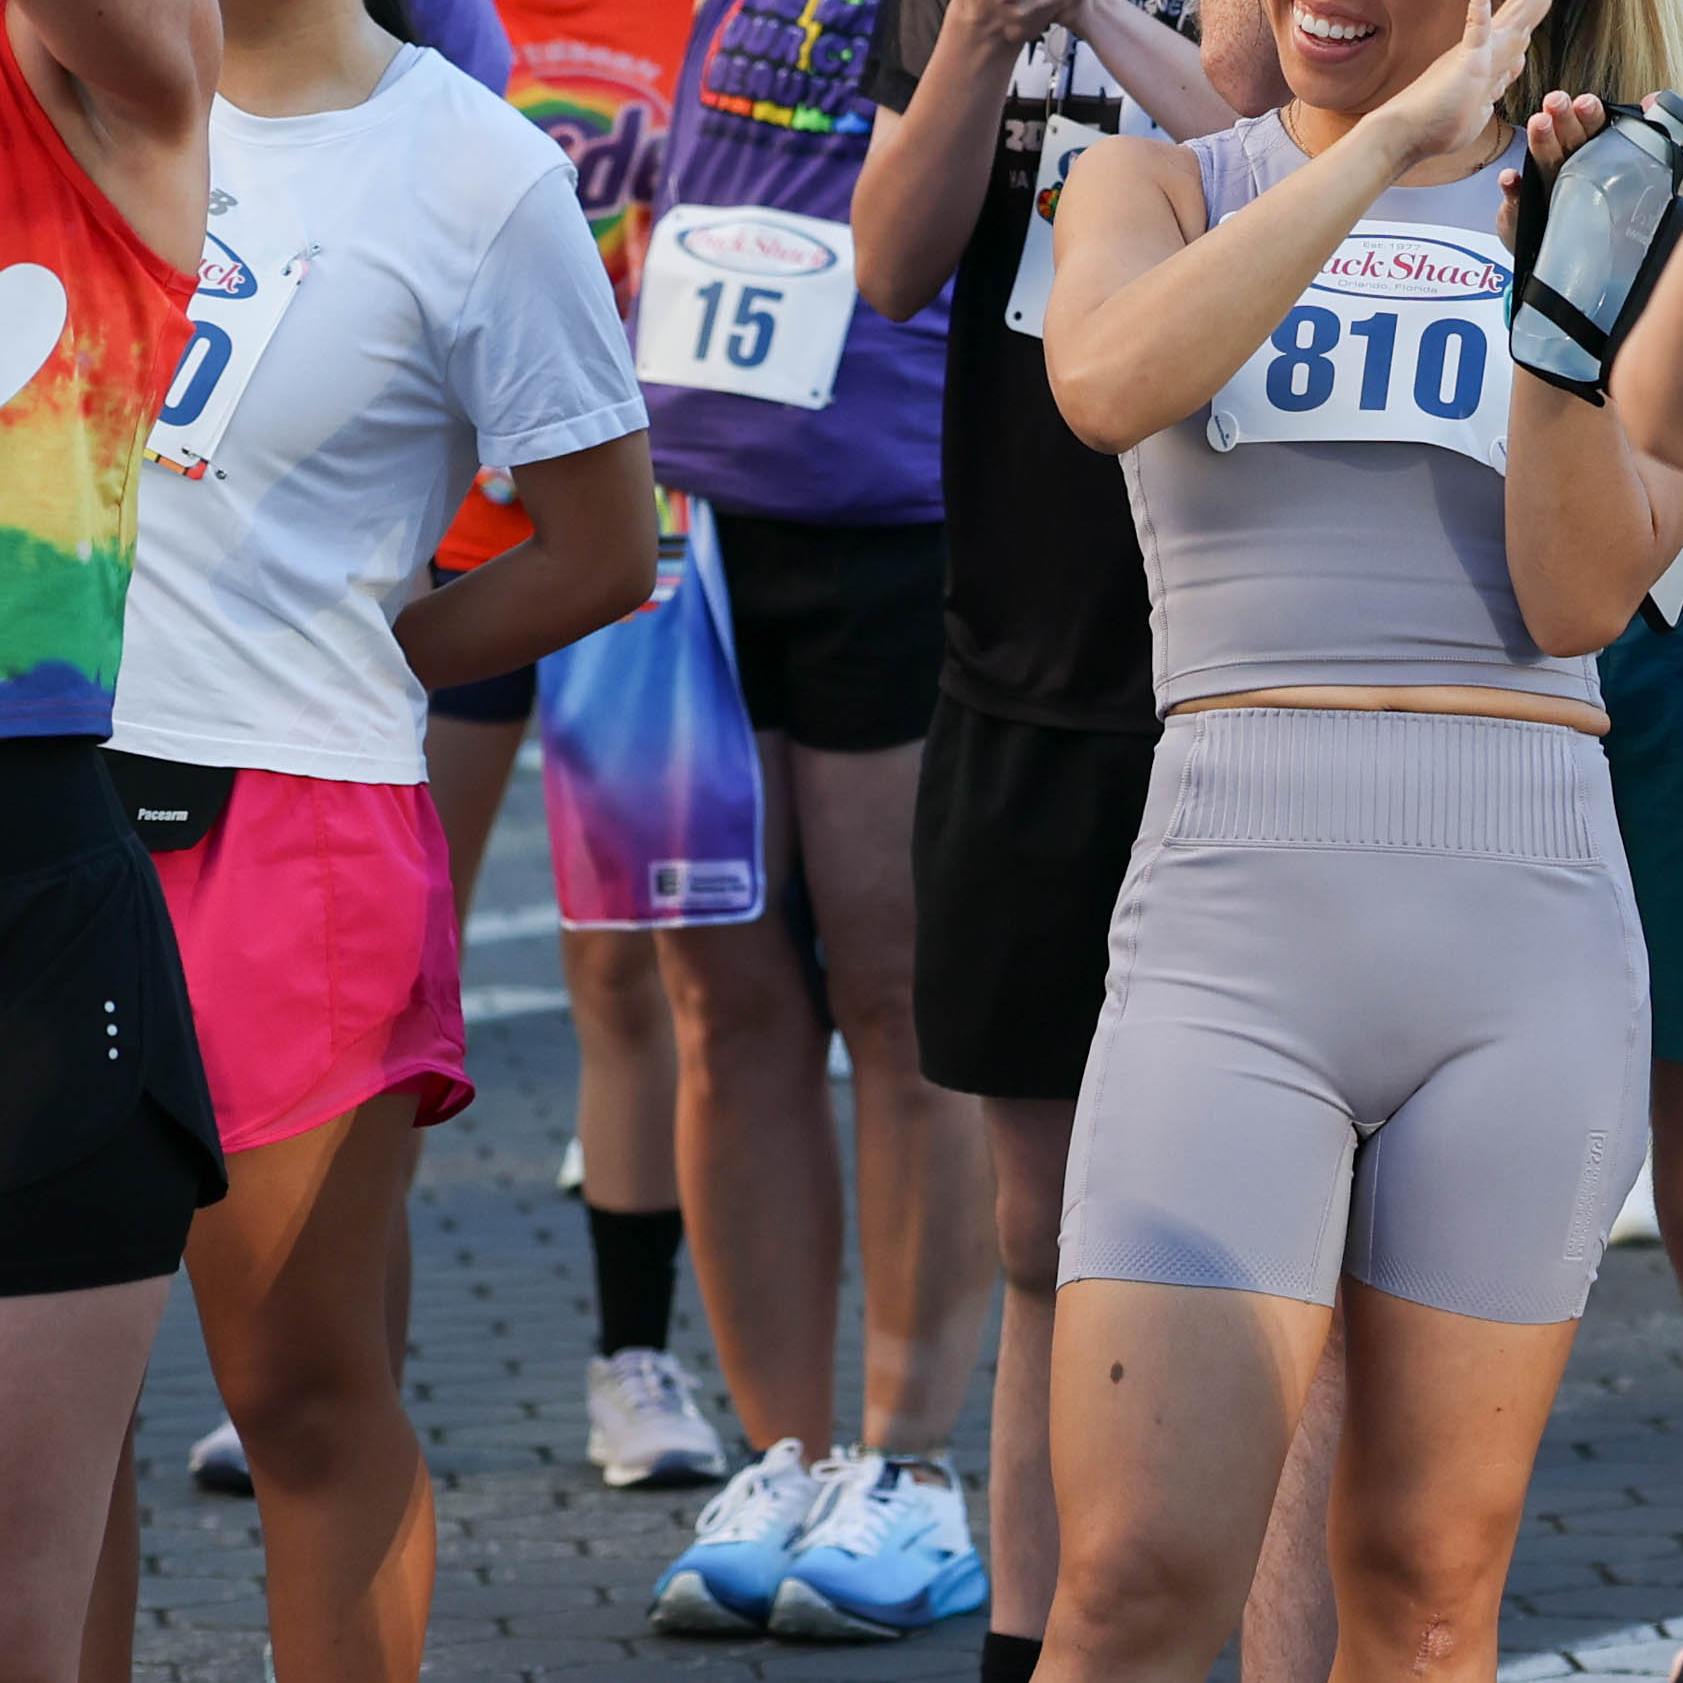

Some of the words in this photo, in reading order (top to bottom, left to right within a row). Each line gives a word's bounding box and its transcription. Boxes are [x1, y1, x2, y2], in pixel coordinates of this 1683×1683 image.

[1337, 277, 1393, 291] Orlando,
[1394, 282, 1439, 295] Florida
[1386, 252, 1504, 293] Shack
[694, 281, 783, 369] 15
[1265, 305, 1488, 421] 810
[137, 807, 189, 821] Pacearm
